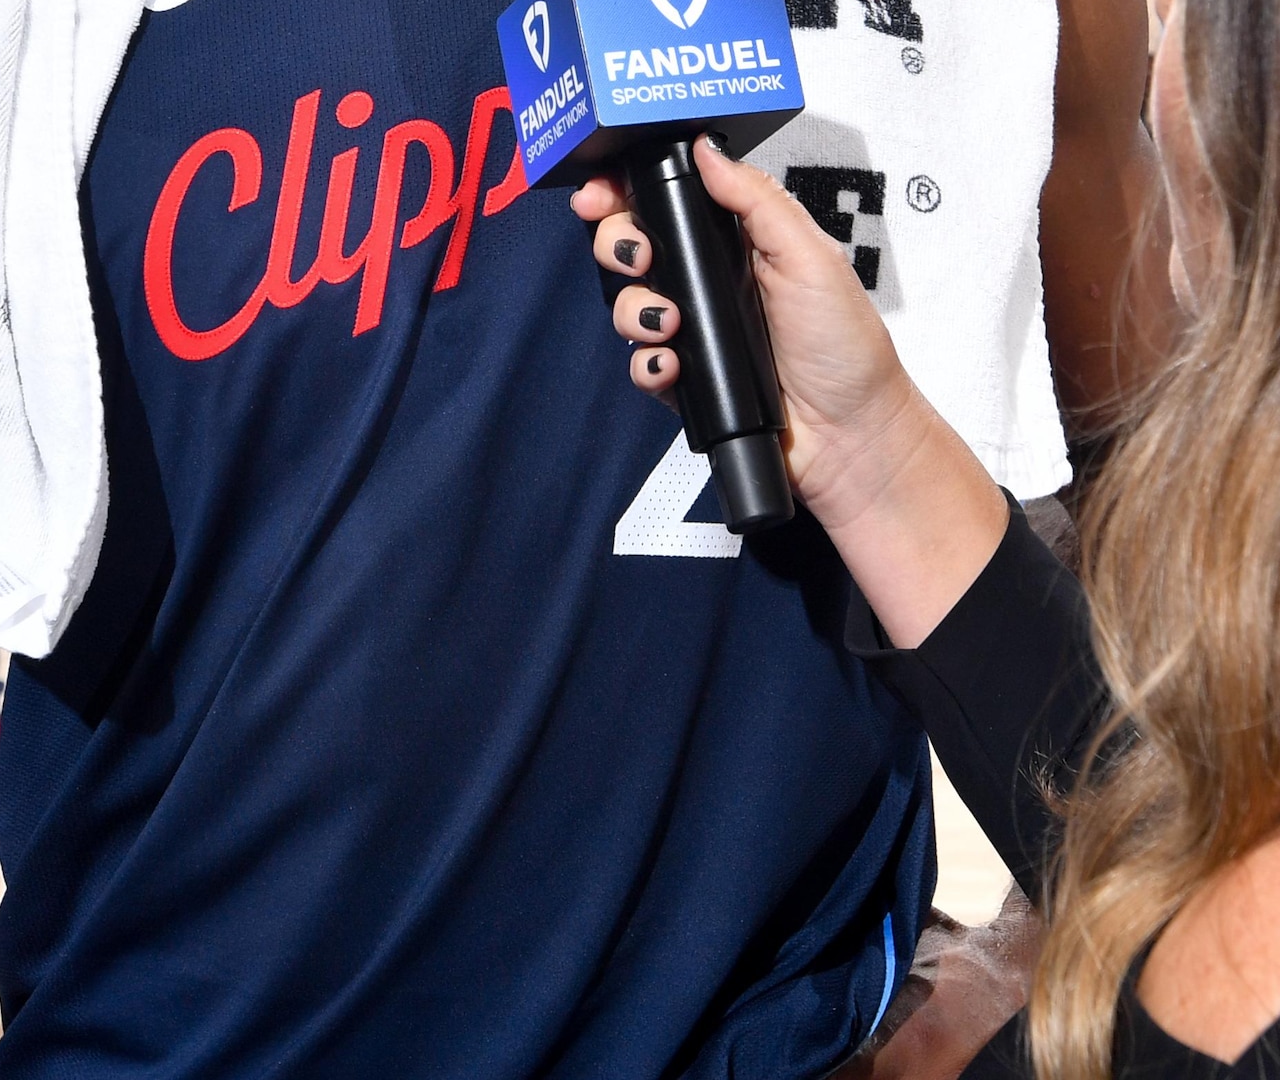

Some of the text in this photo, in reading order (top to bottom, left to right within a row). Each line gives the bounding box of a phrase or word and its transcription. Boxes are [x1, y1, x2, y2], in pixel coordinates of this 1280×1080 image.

[604, 39, 781, 82] FANDUEL
[519, 64, 585, 142] FANDUEL
[611, 73, 786, 105] SPORTS NETWORK
[526, 97, 589, 164] SPORTS NETWORK
